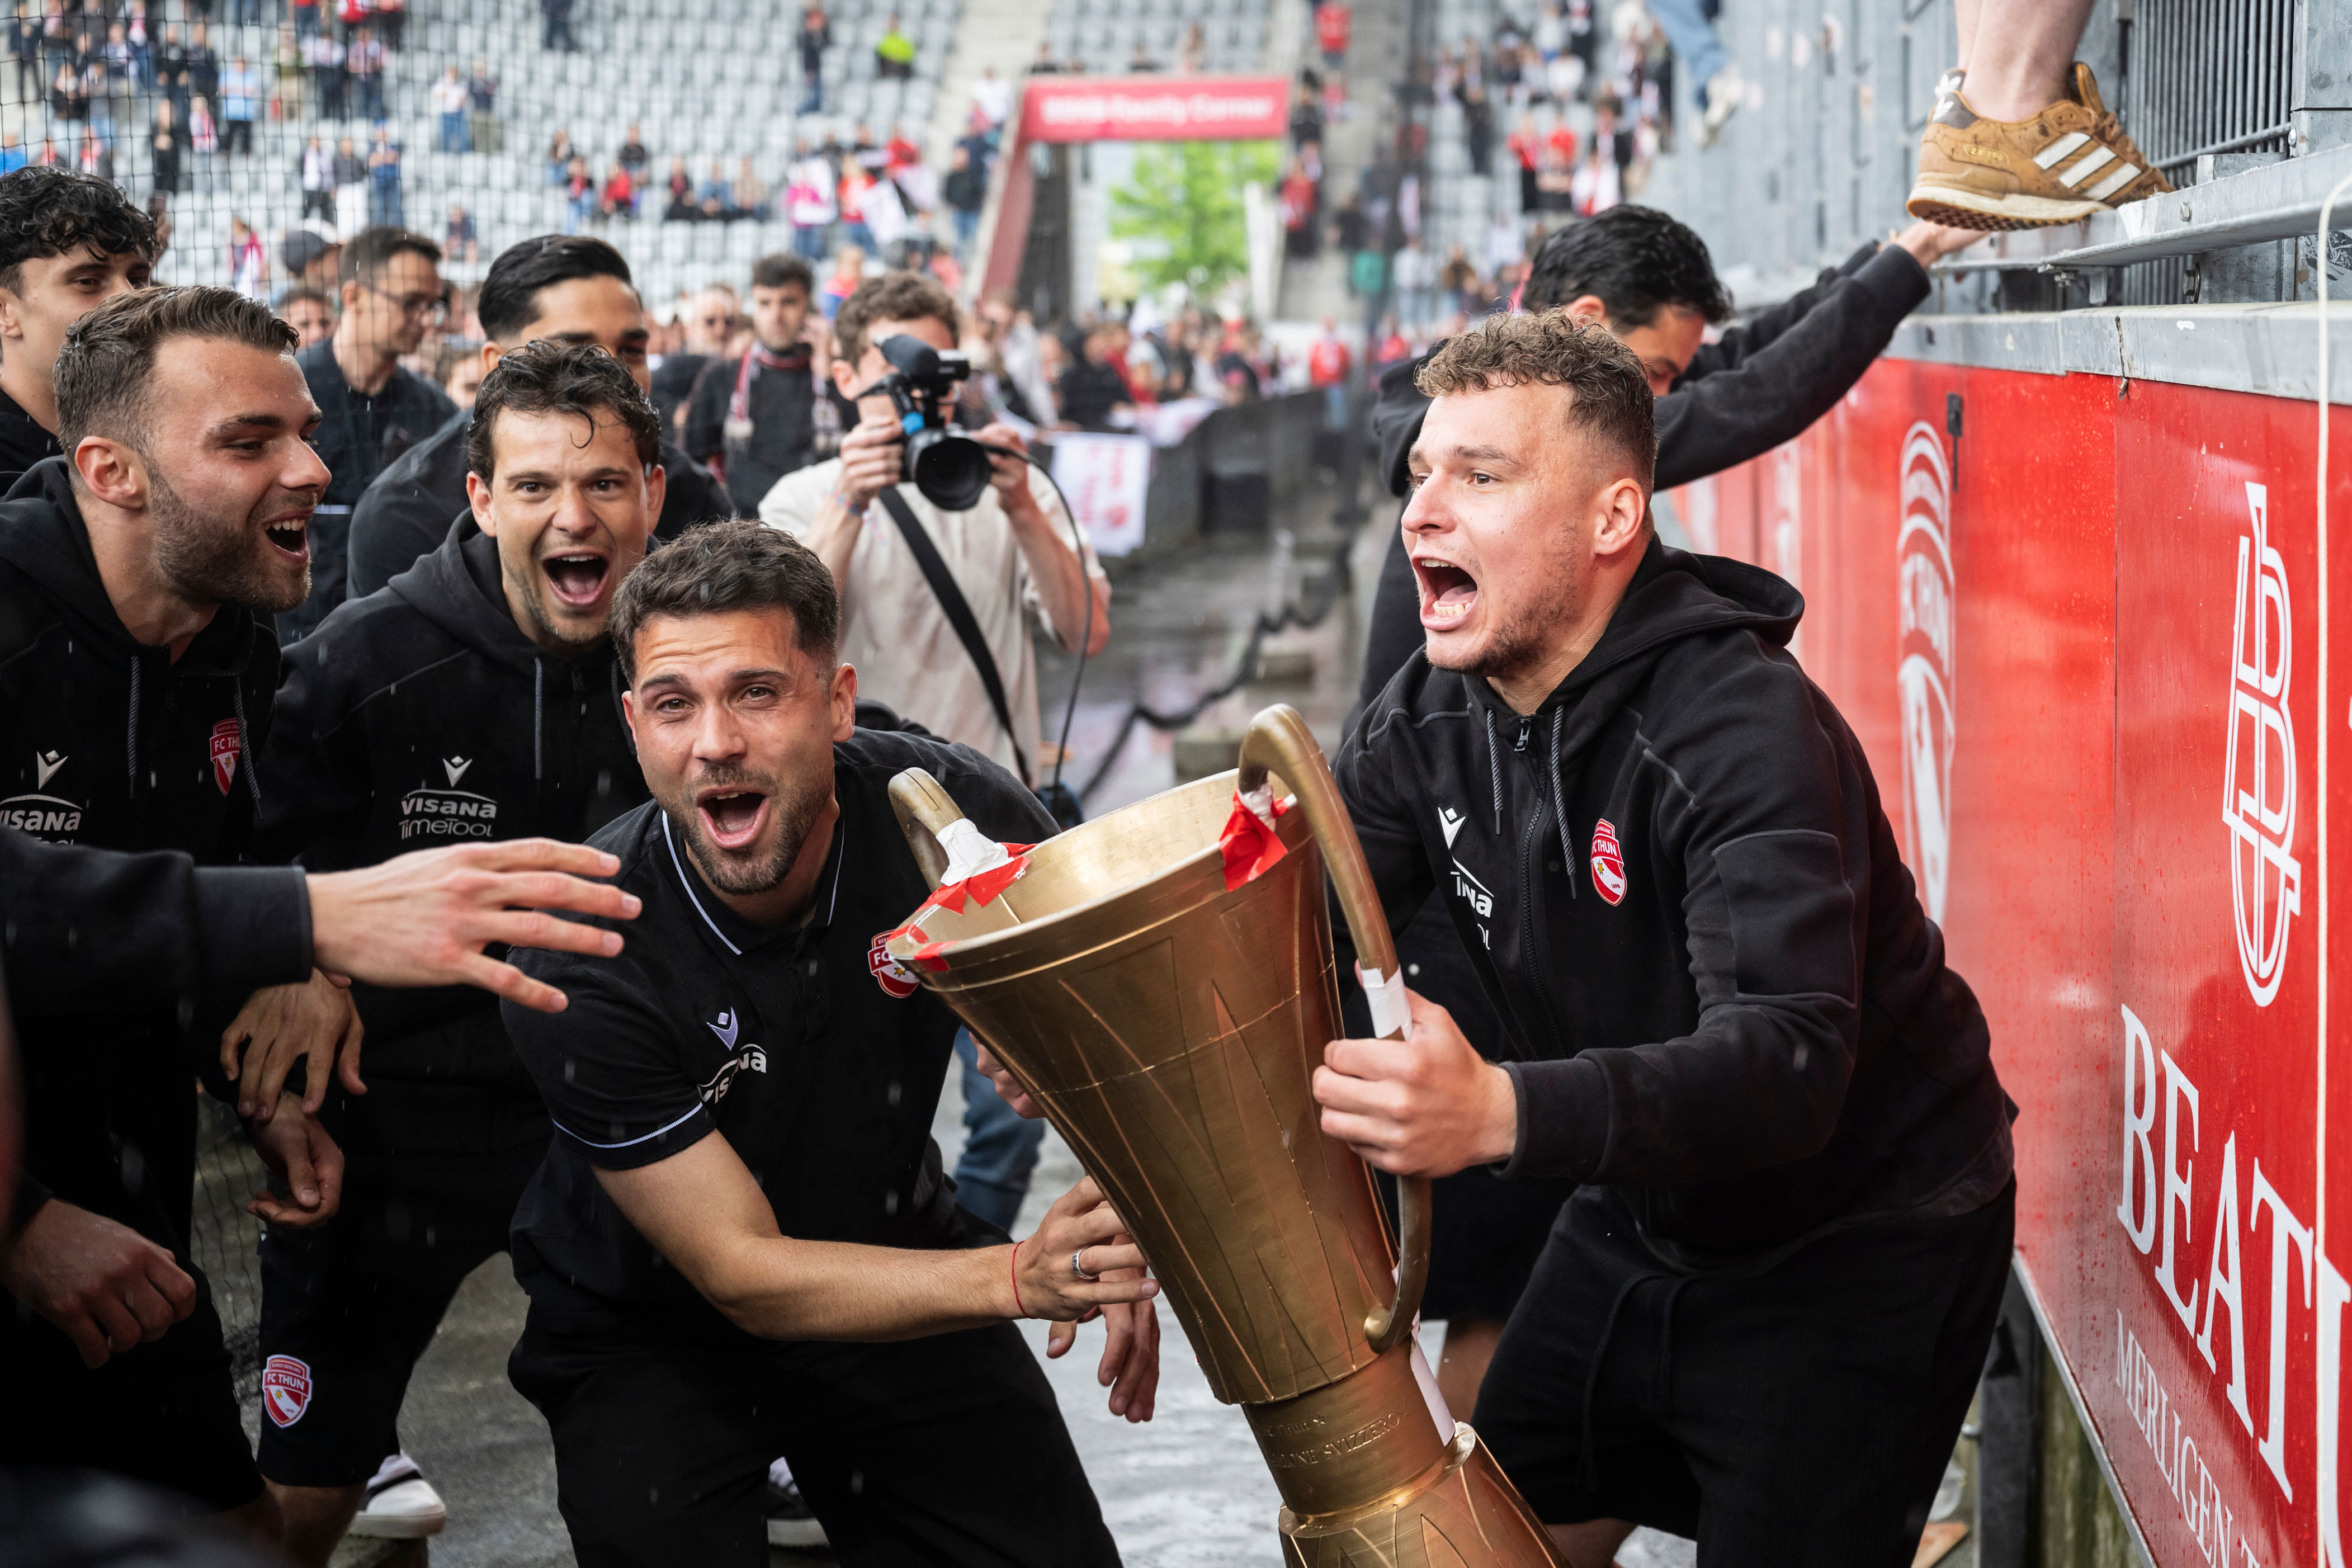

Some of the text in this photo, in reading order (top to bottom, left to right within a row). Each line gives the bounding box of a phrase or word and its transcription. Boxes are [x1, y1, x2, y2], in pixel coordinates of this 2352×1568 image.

[214, 736, 240, 752] FC THU
[1597, 839, 1618, 857] THUN
[874, 950, 890, 965] FC
[267, 1373, 305, 1390] FC THUN
[1323, 1413, 1400, 1460] SVIZZERO
[2116, 1309, 2233, 1568] MERLIGEN
